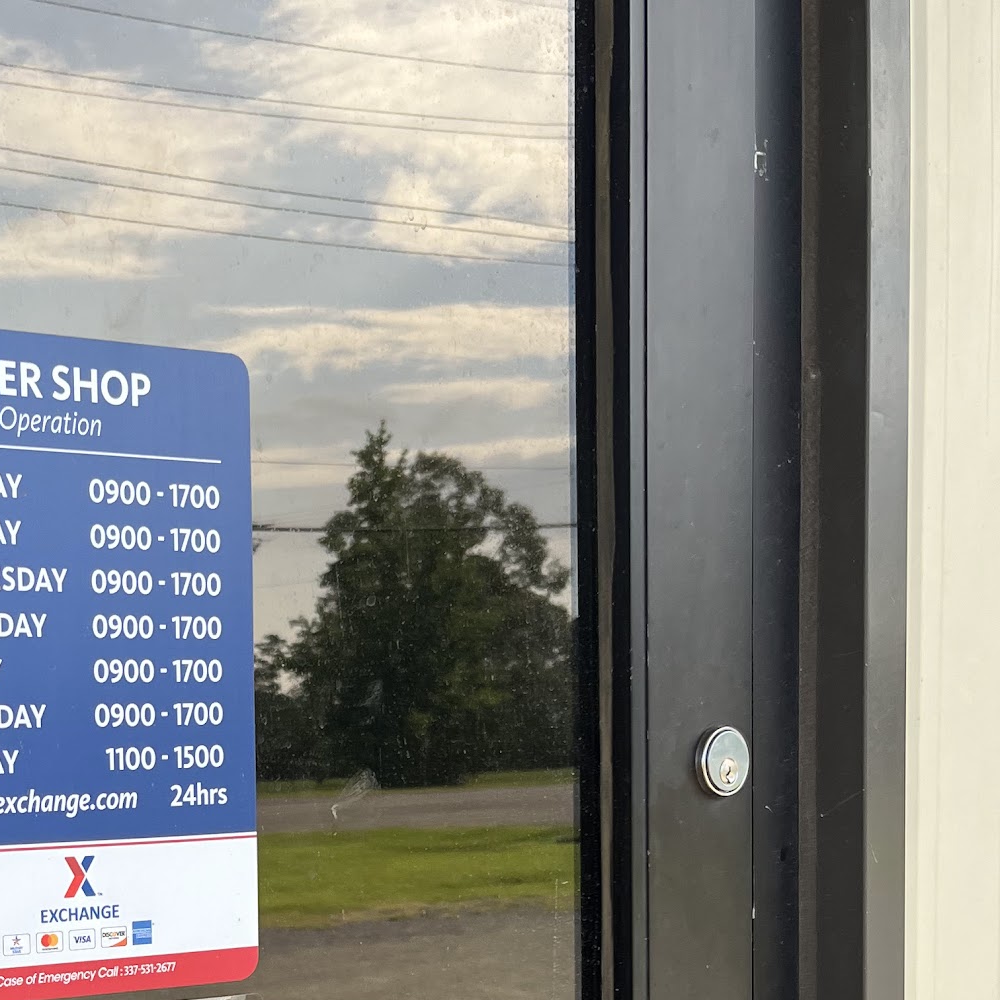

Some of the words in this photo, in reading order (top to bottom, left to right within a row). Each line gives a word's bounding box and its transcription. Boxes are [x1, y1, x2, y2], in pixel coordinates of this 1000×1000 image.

[52, 365, 152, 406] SHOP
[0, 406, 102, 438] Operation
[89, 478, 151, 506] 0900
[169, 484, 220, 510] 1700
[90, 524, 152, 551] 0900
[170, 528, 221, 554] 1700
[91, 569, 153, 596] 0900
[171, 572, 222, 597] 1700
[92, 614, 154, 640] 0900
[172, 616, 222, 640] 1700
[94, 658, 154, 684] 0900
[172, 659, 223, 683] 1700
[94, 702, 156, 728] 0900
[173, 702, 224, 726] 1700
[105, 746, 156, 772] 1100
[174, 744, 224, 770] 1500
[170, 782, 228, 808] 24hrs
[40, 904, 120, 924] EXCHANGE
[74, 936, 92, 944] VISA
[102, 930, 126, 938] DISCOVER
[25, 972, 38, 985] of
[38, 969, 96, 985] Emergency
[98, 966, 119, 978] Call
